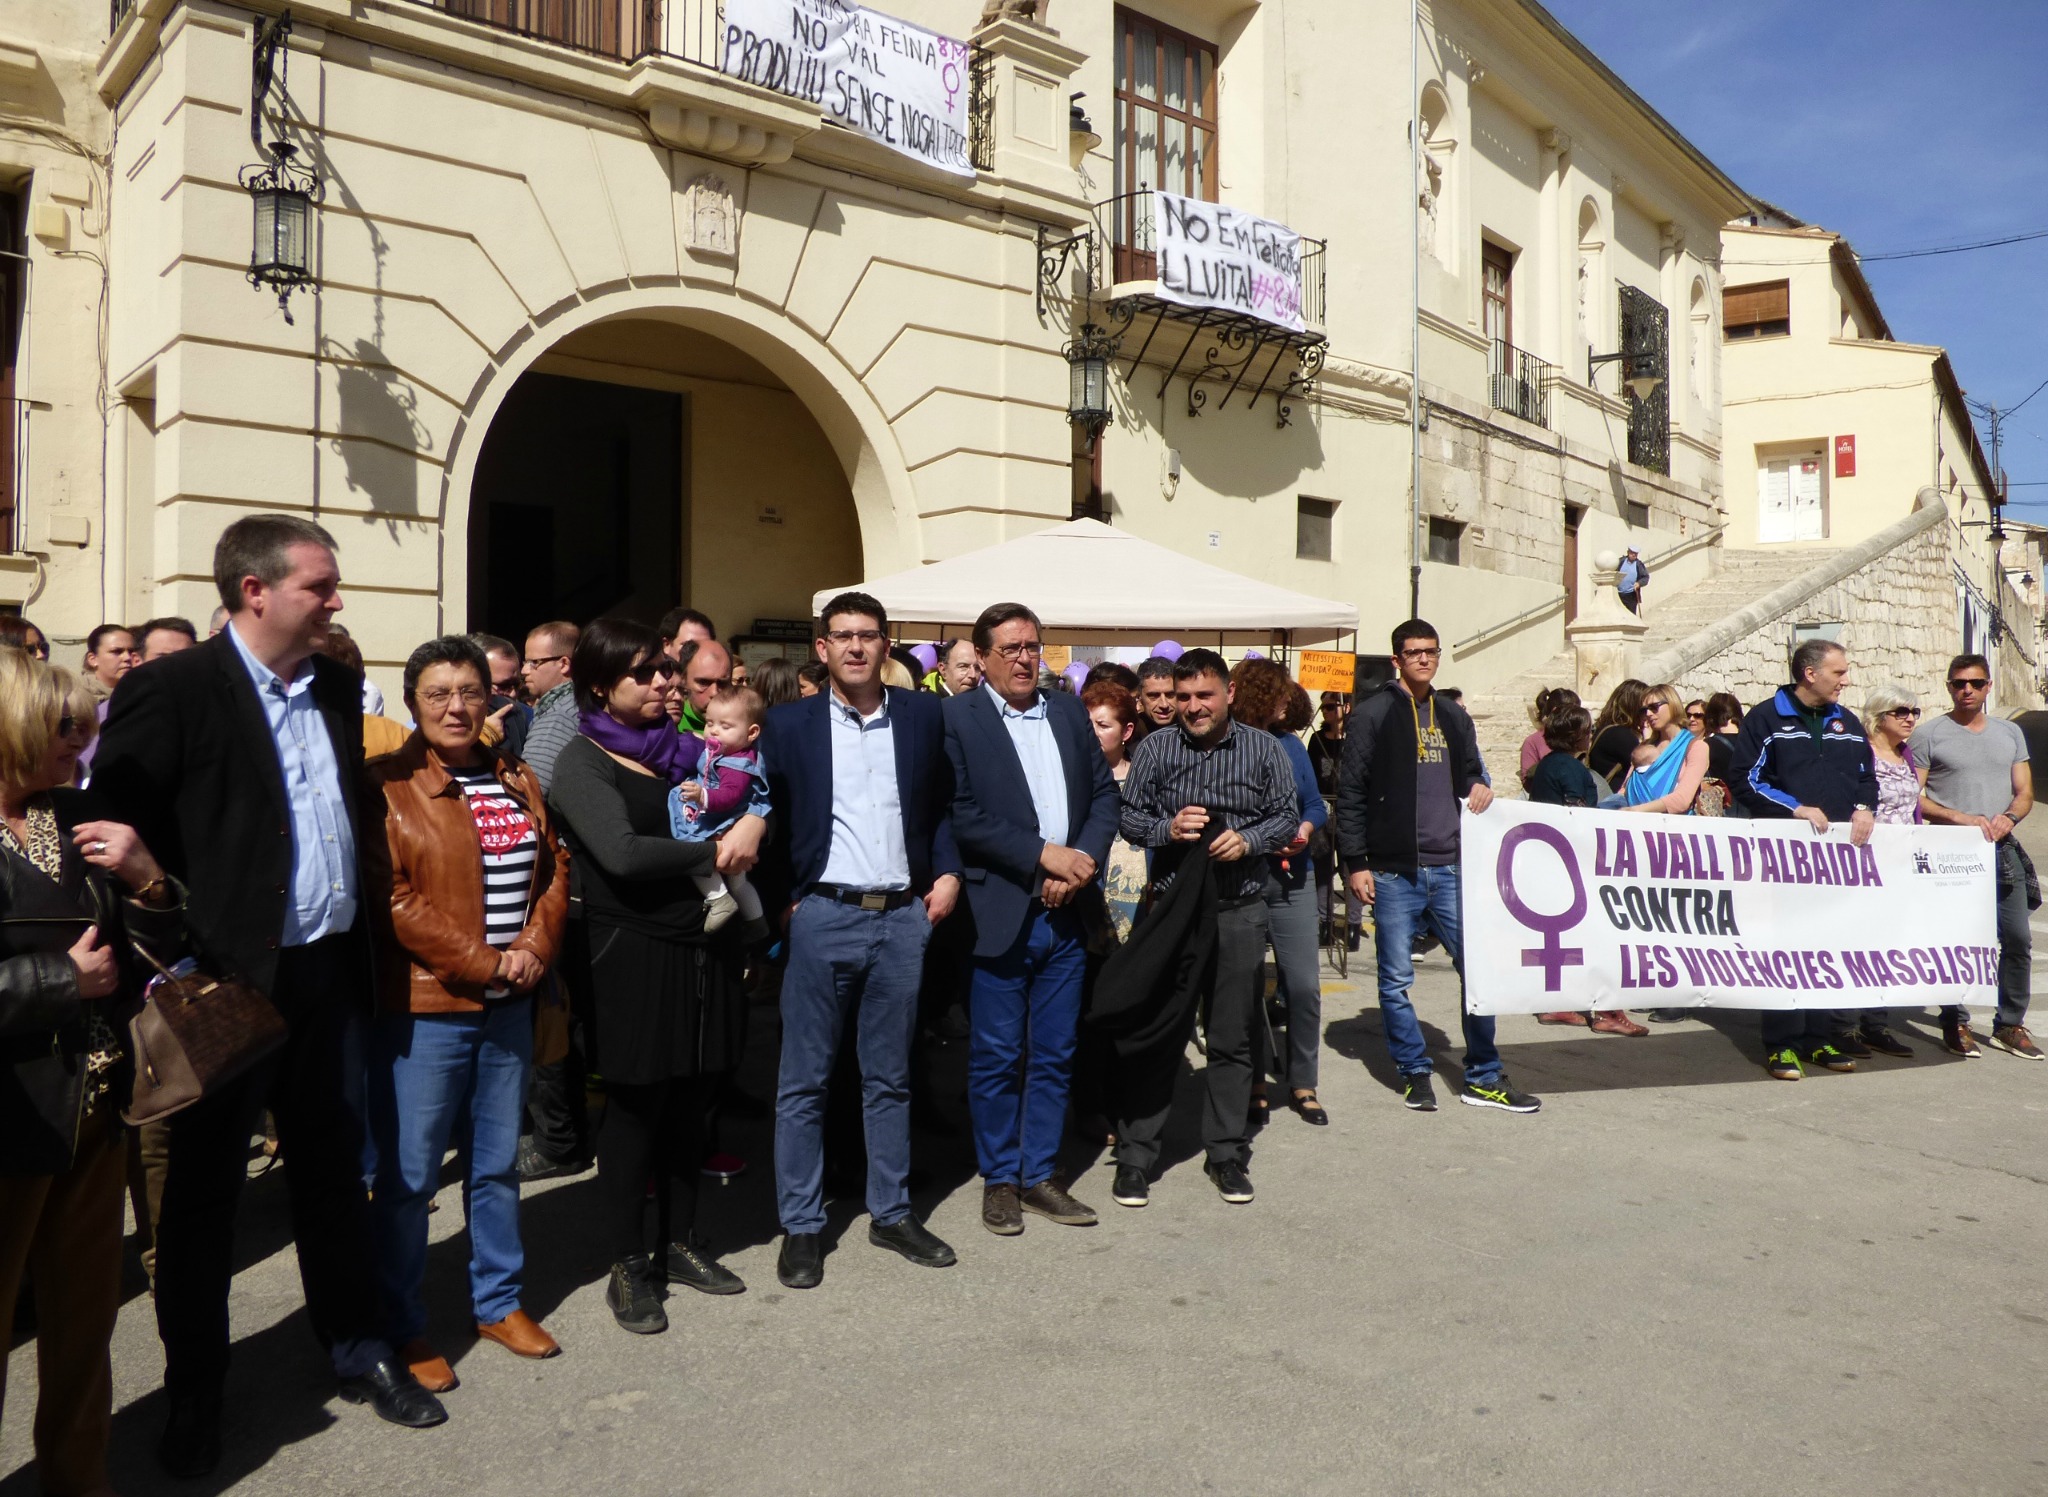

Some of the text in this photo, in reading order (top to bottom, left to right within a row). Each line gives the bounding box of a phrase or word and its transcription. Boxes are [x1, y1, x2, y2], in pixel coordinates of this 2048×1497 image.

[793, 6, 887, 78] NO VAL
[938, 36, 969, 71] 8M
[832, 69, 896, 144] SENSE
[1301, 664, 1332, 675] AJUDA?
[1595, 828, 1884, 888] LA VALL D'ALBAIDA
[1938, 862, 1987, 875] Ontinyent
[1598, 885, 1741, 937] CONTRA
[1619, 942, 2000, 991] LES VIOLÈNCIES MASCLISTES
